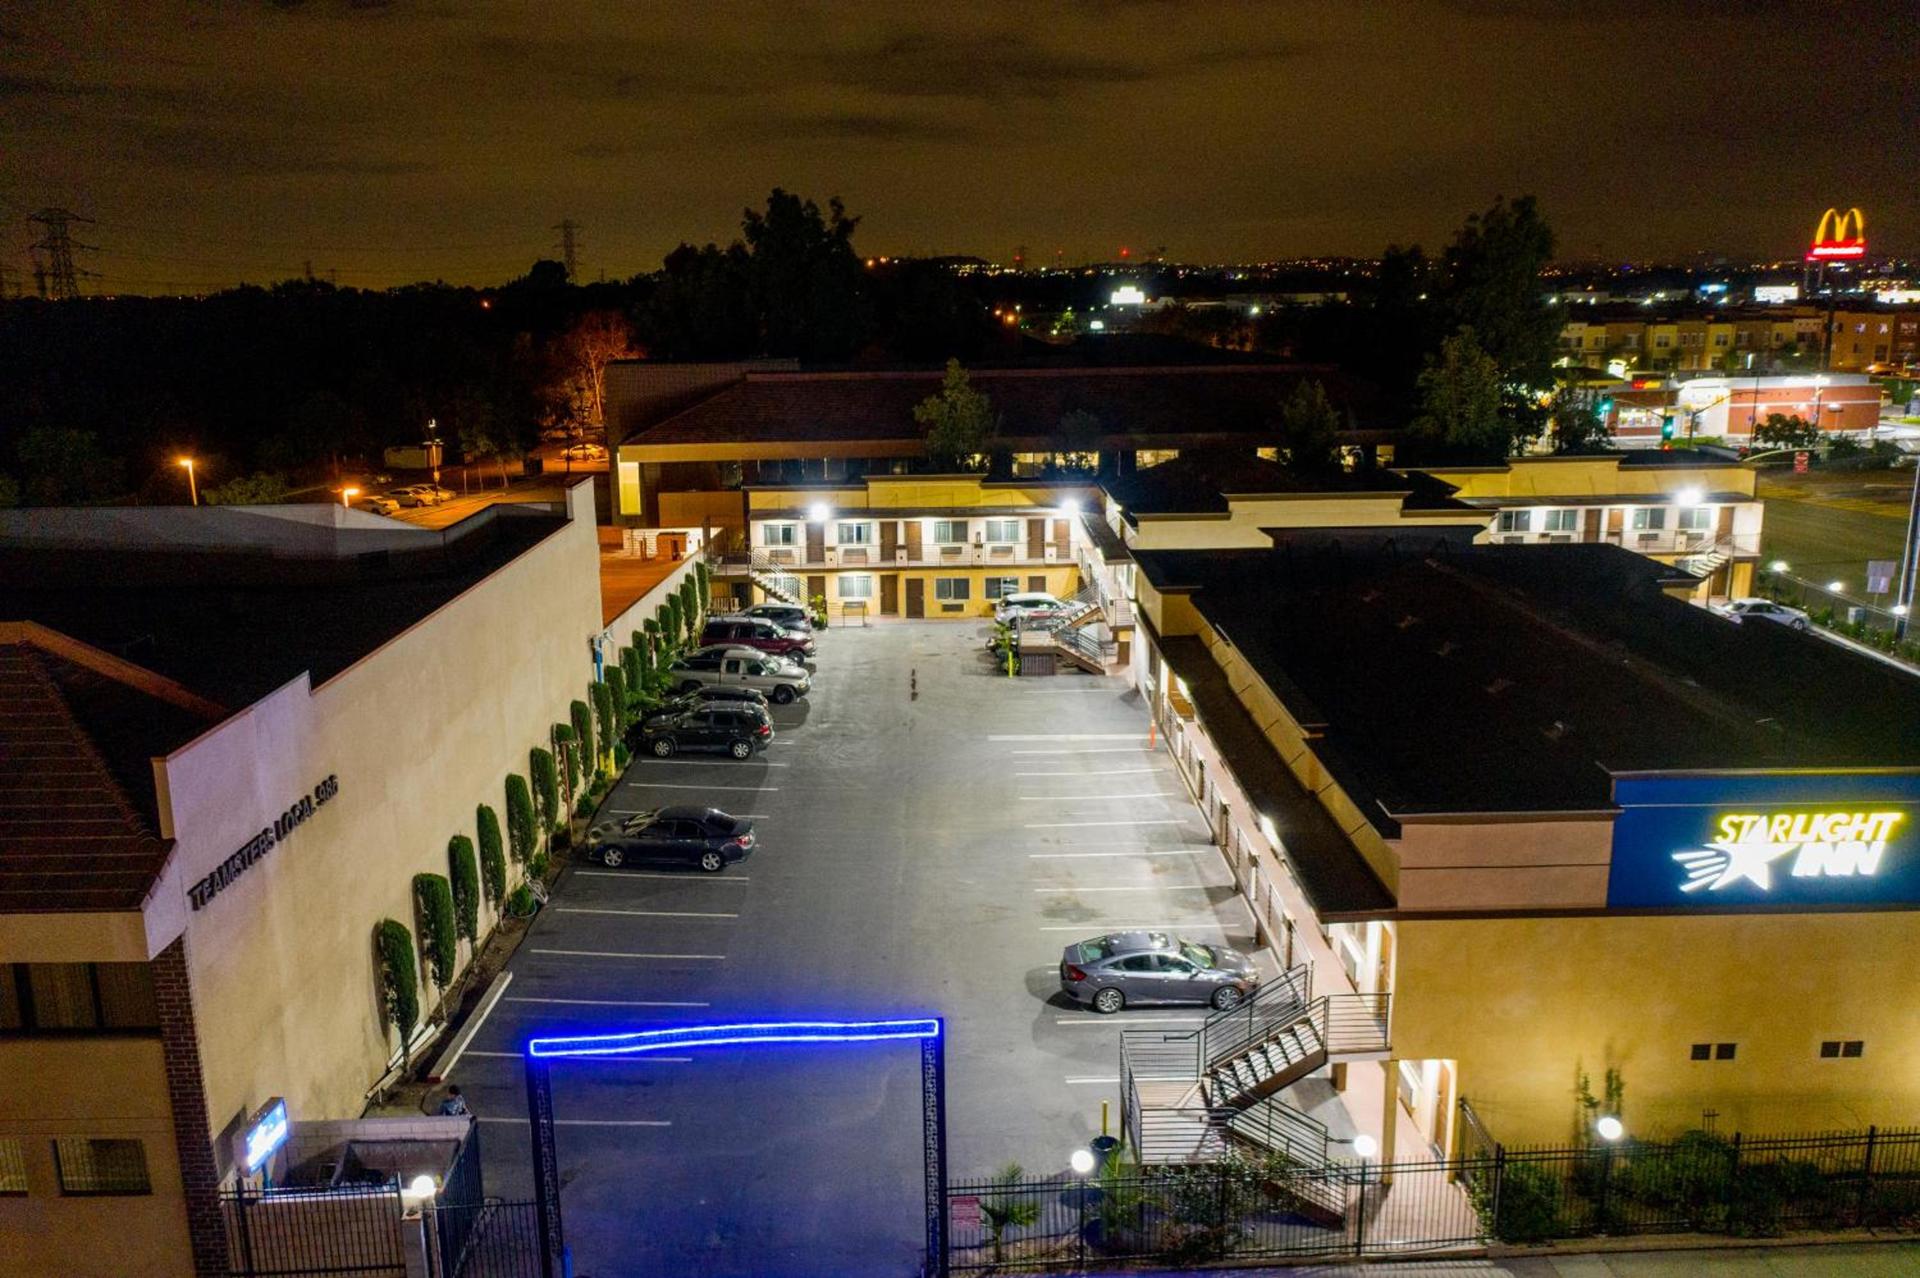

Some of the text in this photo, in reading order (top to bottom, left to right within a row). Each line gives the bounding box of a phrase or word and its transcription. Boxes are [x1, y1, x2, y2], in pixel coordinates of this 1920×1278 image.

[187, 775, 338, 911] TEAMSTERS LOCAL 986
[1715, 813, 1904, 843] STARLIGHT
[1792, 842, 1885, 876] INN
